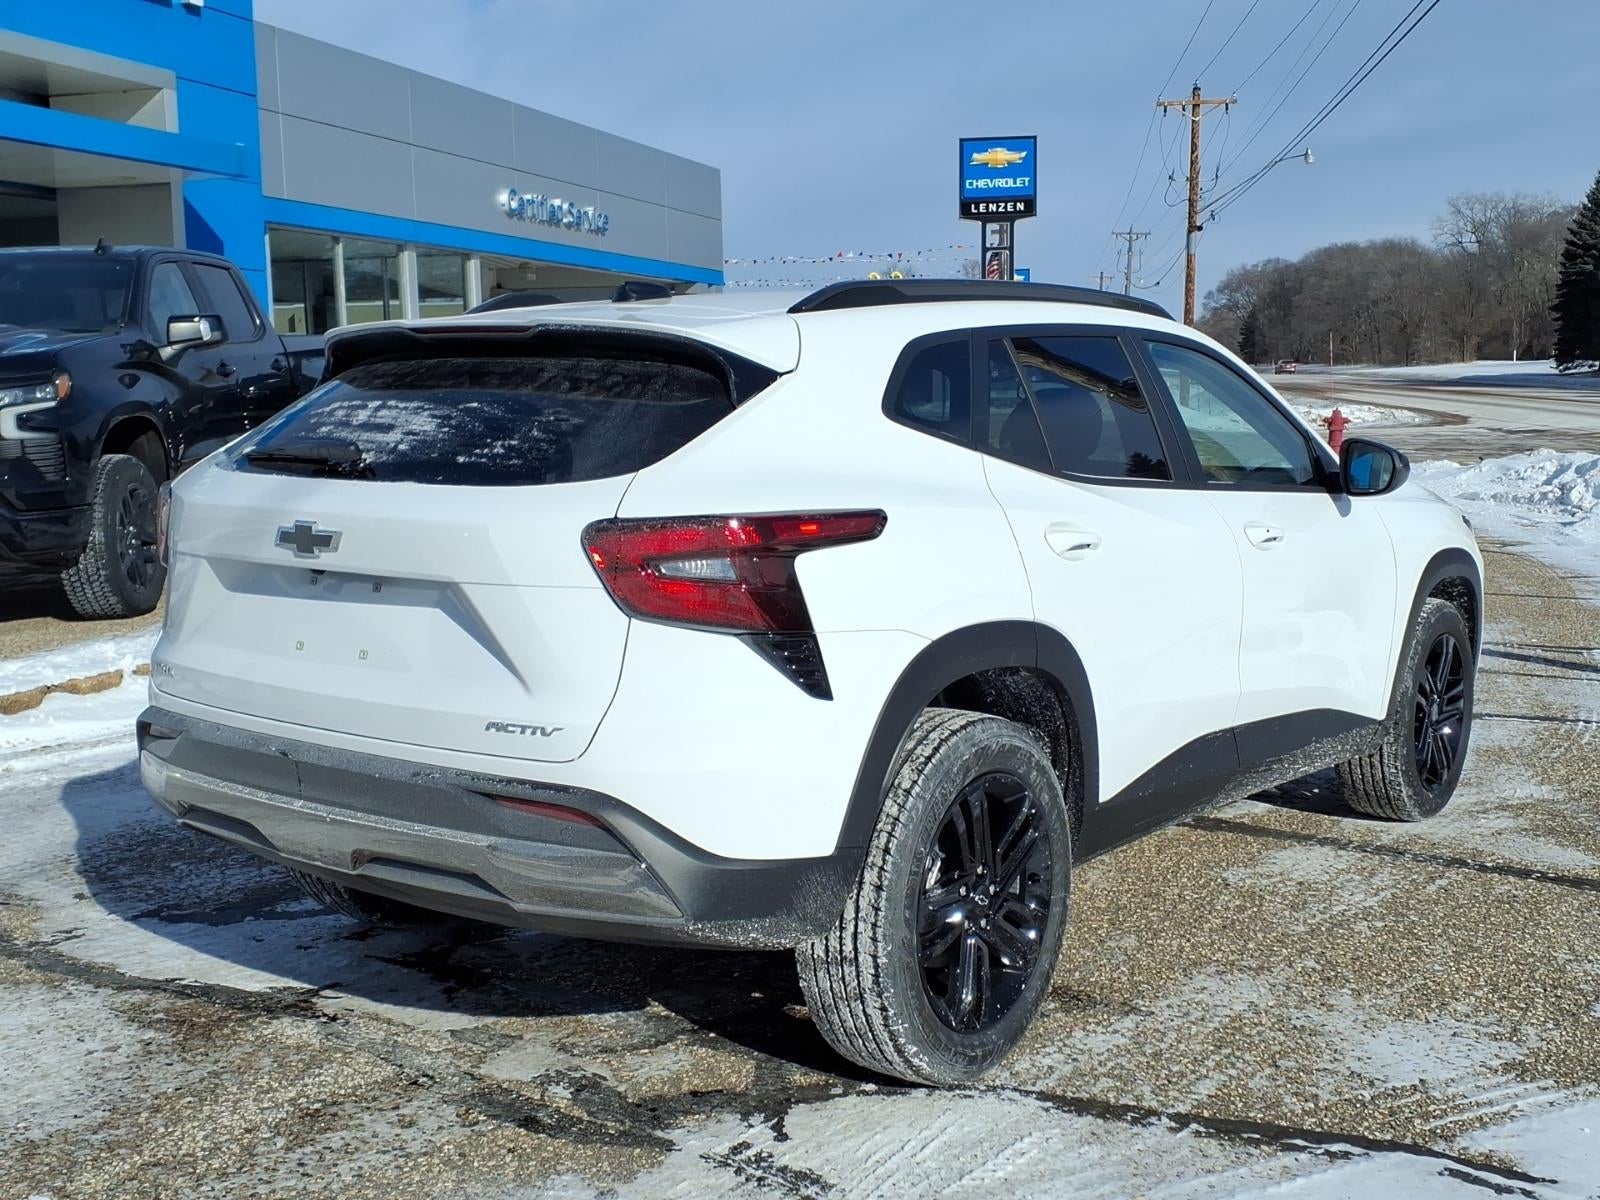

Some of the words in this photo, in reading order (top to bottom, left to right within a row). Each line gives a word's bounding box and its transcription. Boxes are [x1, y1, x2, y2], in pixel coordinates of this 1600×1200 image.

[965, 177, 1030, 189] CHEVROLET
[505, 187, 563, 225] Certified
[563, 201, 609, 234] Service
[971, 202, 1025, 213] LENZEN
[485, 721, 565, 737] ACTIV
